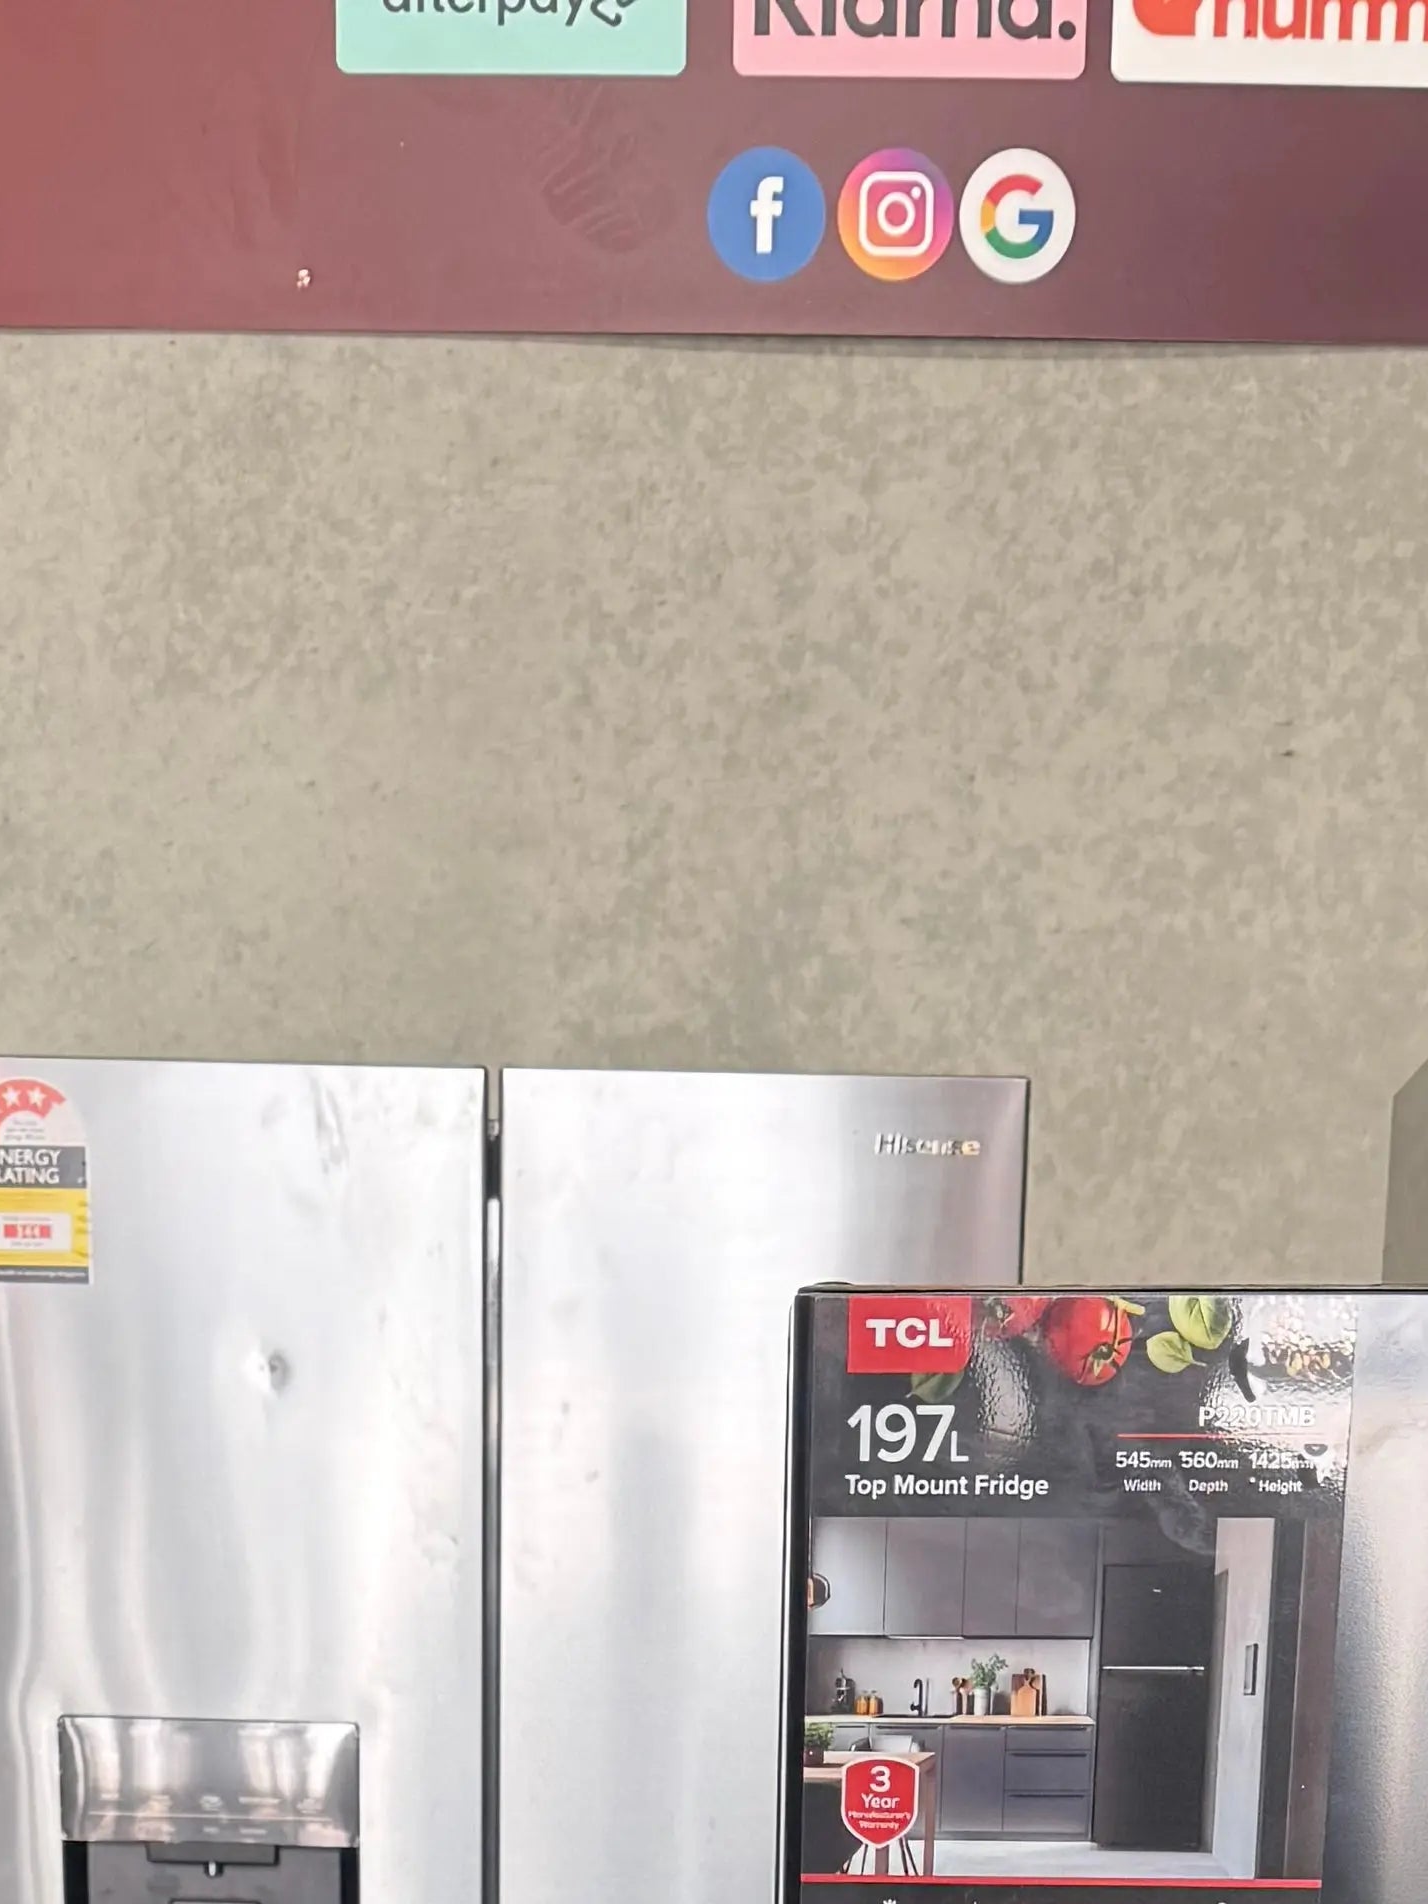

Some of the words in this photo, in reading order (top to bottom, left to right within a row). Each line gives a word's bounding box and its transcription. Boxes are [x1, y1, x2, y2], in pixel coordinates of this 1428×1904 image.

[865, 1318, 953, 1348] TCL
[1198, 1405, 1316, 1428] P220TMB
[847, 1403, 969, 1463] 197L
[1115, 1450, 1172, 1470] 545mm
[1180, 1450, 1239, 1470] 560mm
[845, 1474, 887, 1500] Top
[894, 1474, 968, 1496] Mount
[974, 1474, 1049, 1500] Fridge
[1123, 1478, 1161, 1493] Width
[1188, 1479, 1229, 1495] Depth
[1258, 1479, 1303, 1495] Height
[870, 1765, 891, 1793] 3
[860, 1792, 901, 1809] Year
